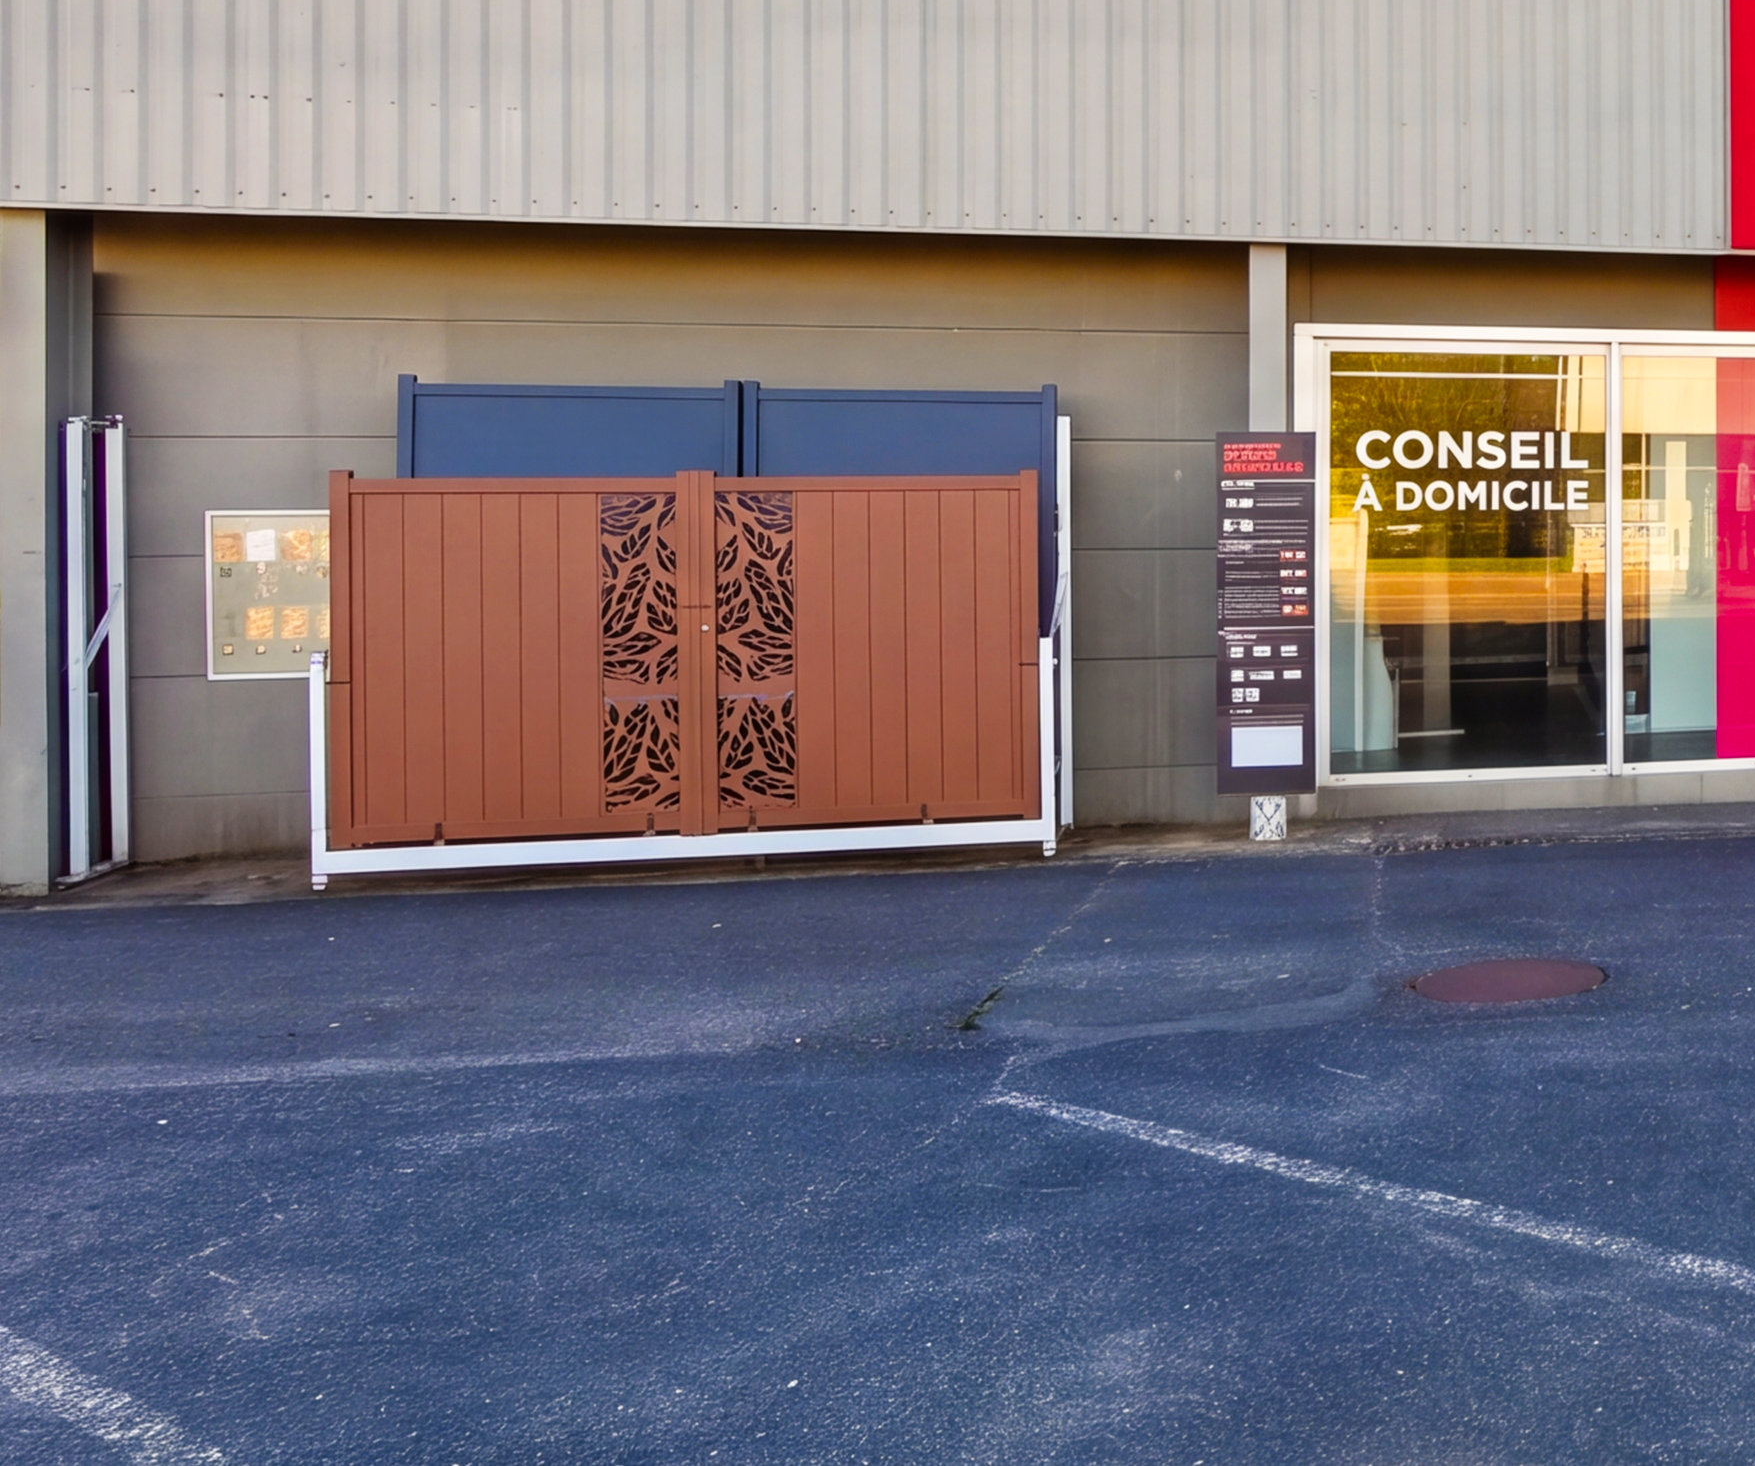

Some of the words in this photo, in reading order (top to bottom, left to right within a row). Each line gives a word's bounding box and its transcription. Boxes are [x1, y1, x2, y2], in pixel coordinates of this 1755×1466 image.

[1355, 429, 1589, 470] CONSEIL
[1352, 473, 1382, 512] À
[1395, 478, 1589, 512] DOMICILE
